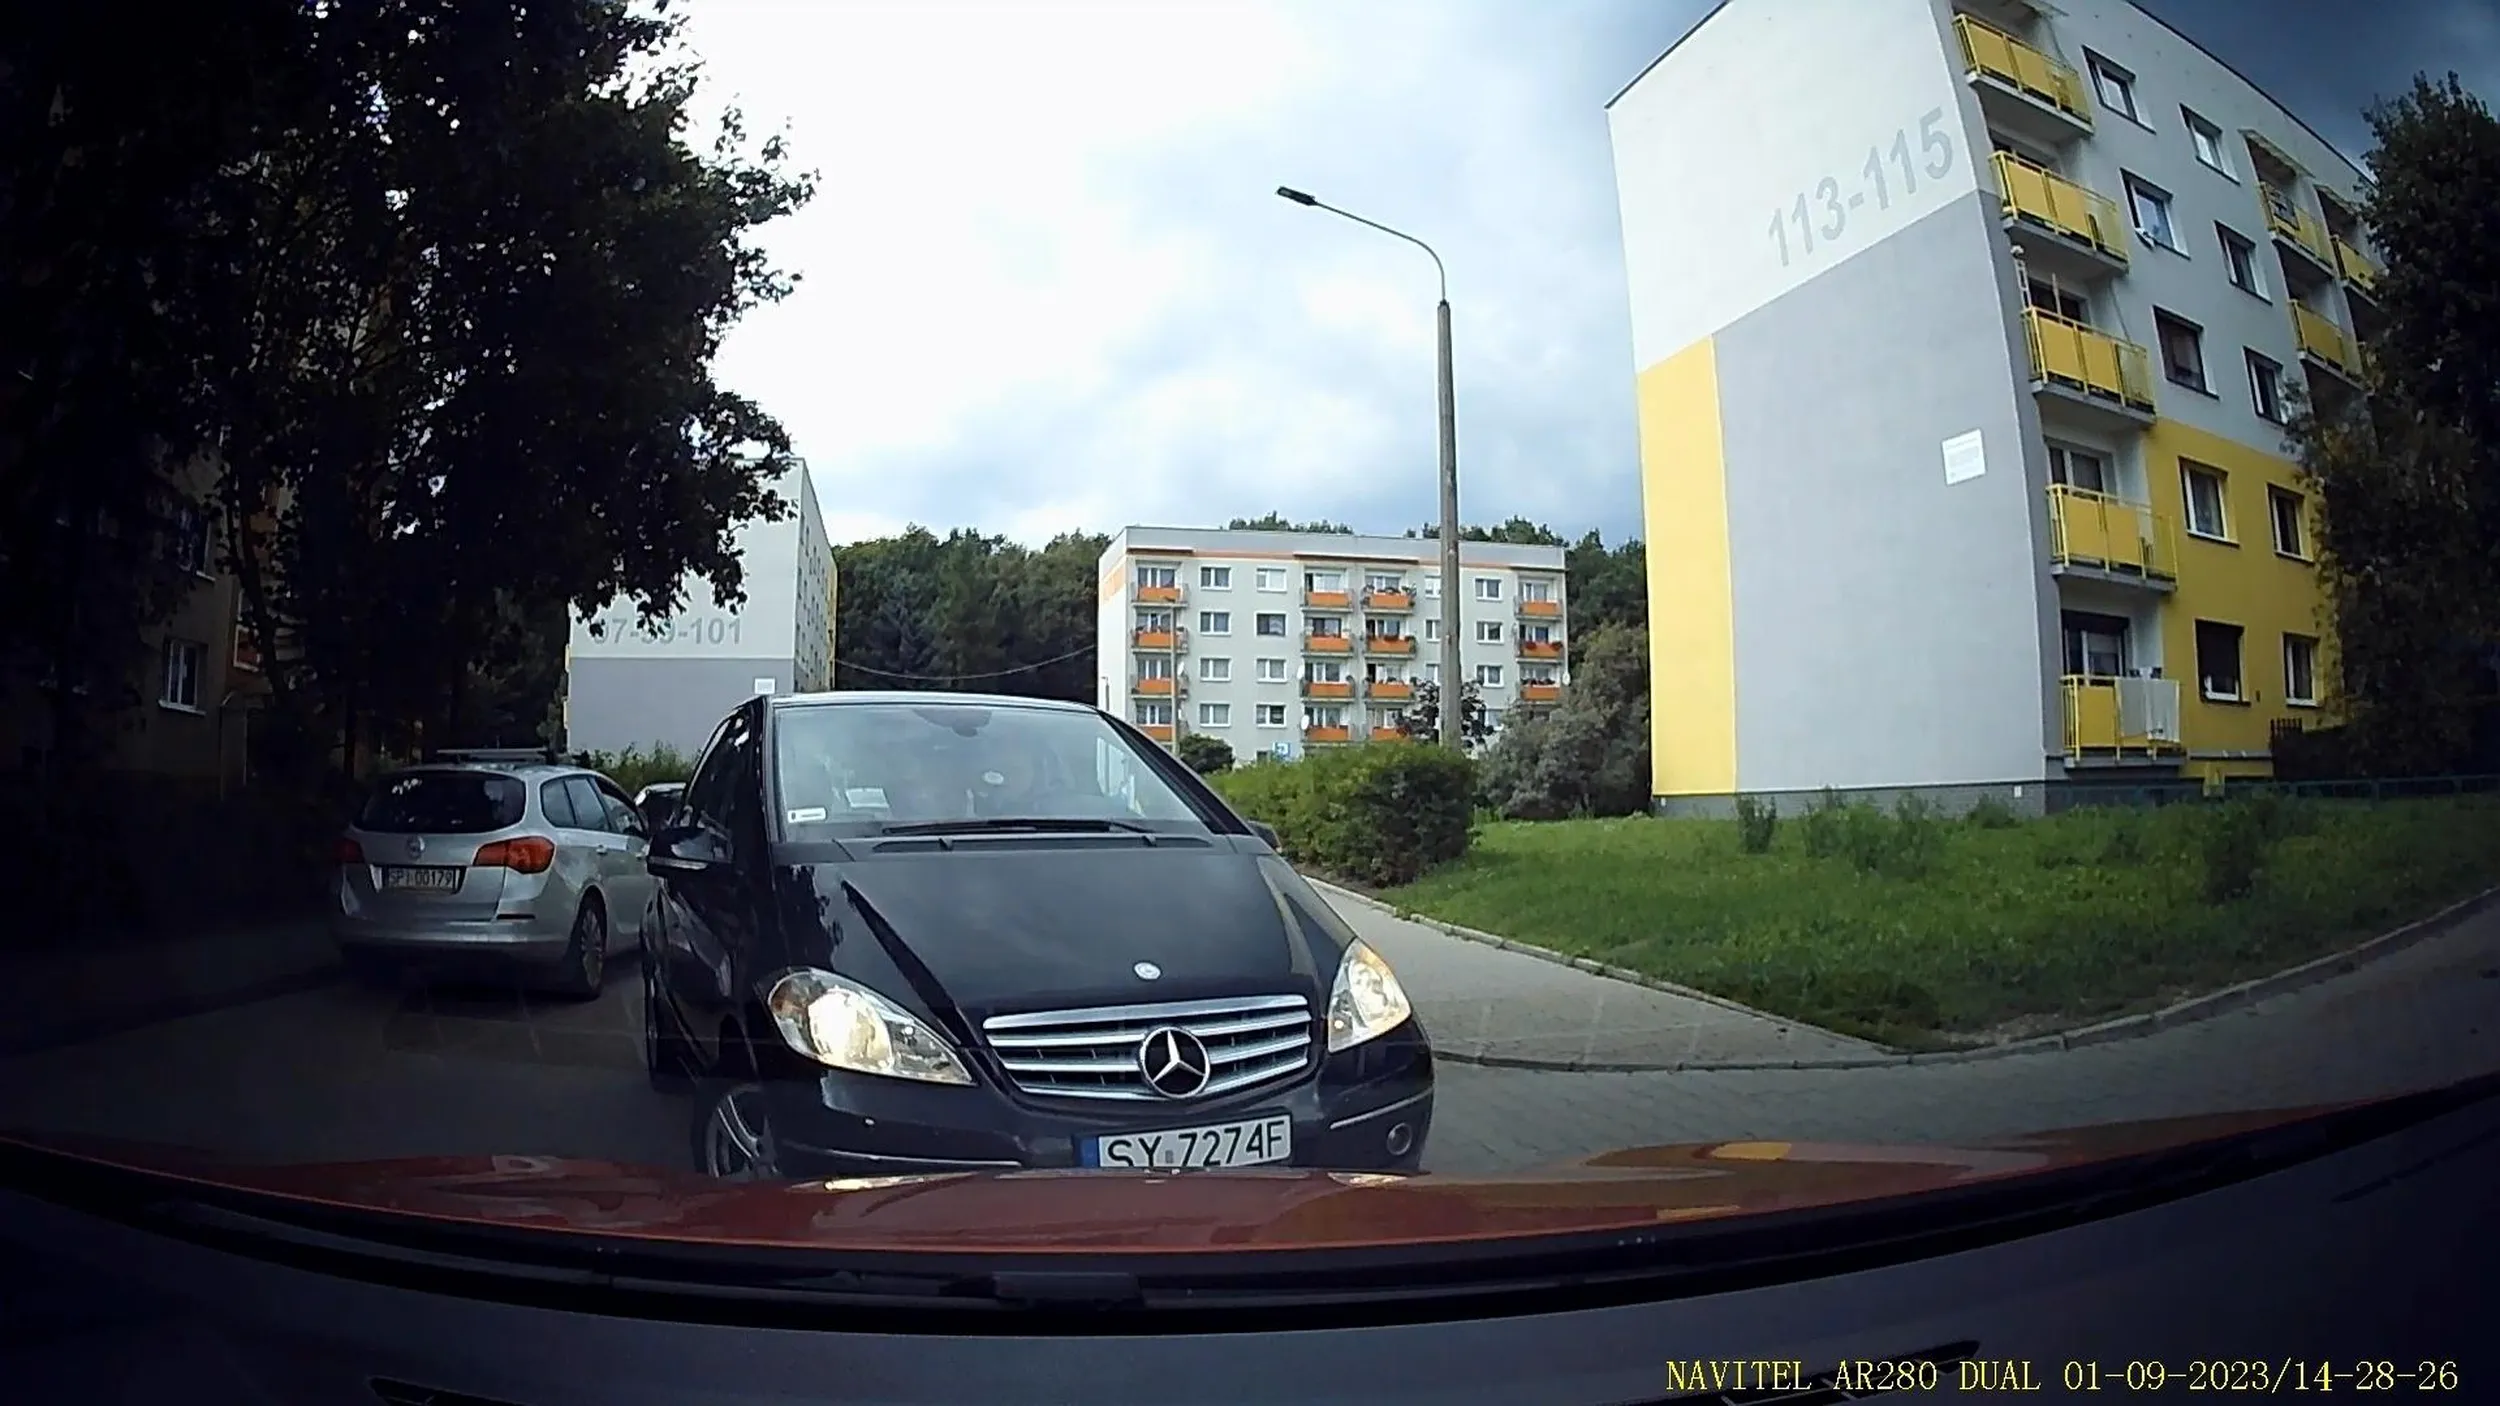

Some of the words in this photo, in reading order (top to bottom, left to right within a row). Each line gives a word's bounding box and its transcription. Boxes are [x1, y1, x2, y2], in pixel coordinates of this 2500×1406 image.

[1768, 106, 1953, 267] 113-115
[1107, 1135, 1162, 1167] SY
[1178, 1121, 1285, 1167] 7274F
